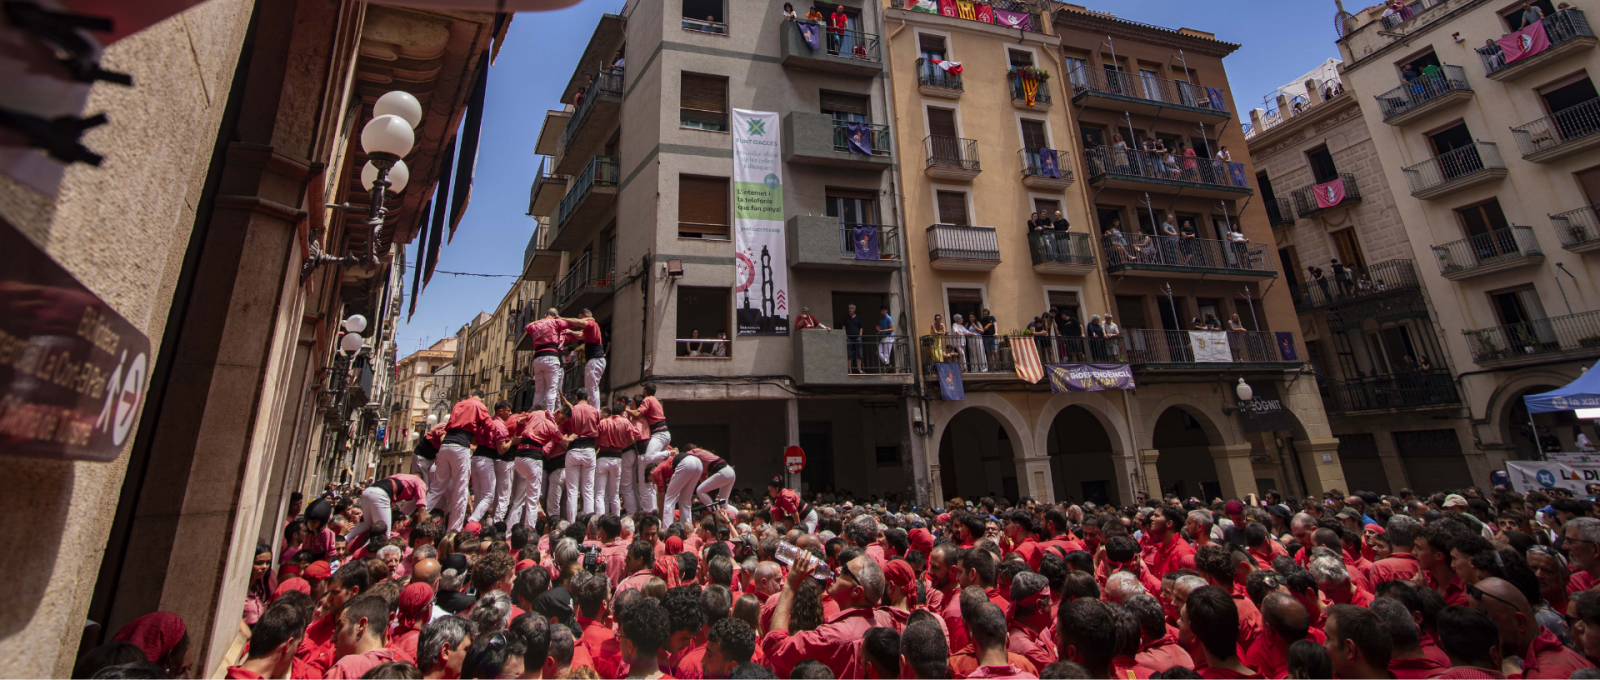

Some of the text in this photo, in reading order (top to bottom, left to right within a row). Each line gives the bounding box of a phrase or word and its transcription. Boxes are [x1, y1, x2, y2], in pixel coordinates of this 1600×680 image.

[737, 188, 767, 197] L'internet
[77, 305, 120, 356] Biblioteca
[1080, 379, 1094, 388] VIA
